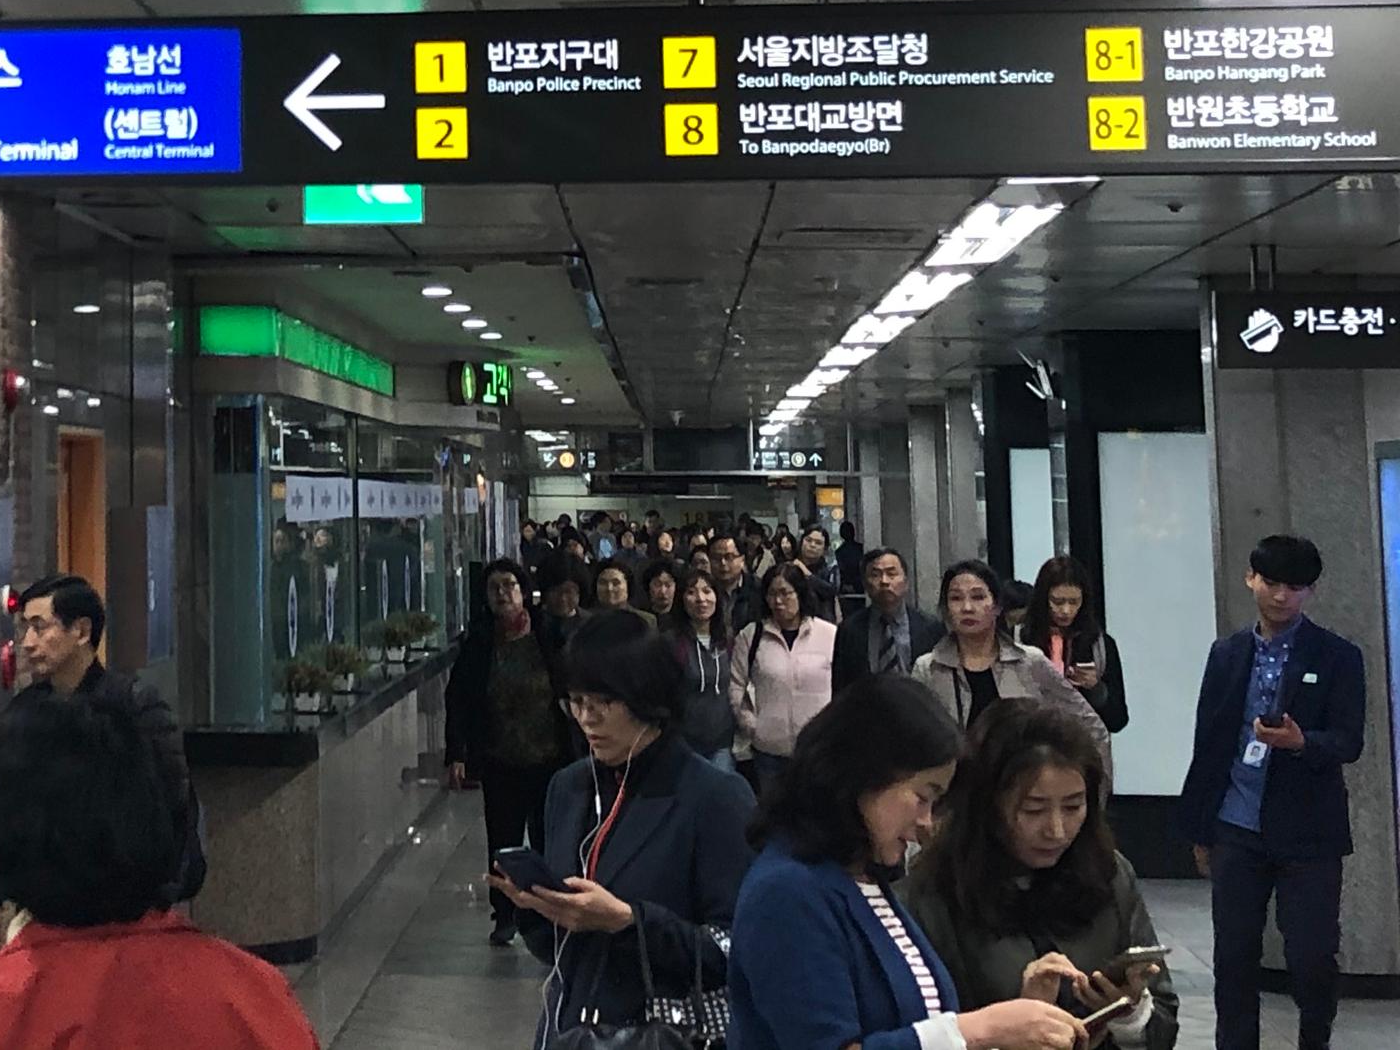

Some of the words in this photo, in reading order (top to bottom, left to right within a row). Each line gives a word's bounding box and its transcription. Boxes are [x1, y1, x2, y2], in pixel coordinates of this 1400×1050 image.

[487, 38, 618, 72] 반포지구대
[737, 33, 928, 67] 서울지방조달청
[1095, 40, 1136, 71] 8-1
[1163, 25, 1334, 60] 반포한강공원
[105, 43, 181, 76] 호남선
[433, 54, 444, 82] 1
[679, 49, 698, 78] 7
[1165, 66, 1215, 84] Banpo
[1217, 65, 1289, 83] Hangang
[1291, 63, 1327, 80] Park
[105, 80, 156, 95] Honam
[157, 80, 186, 95] Line
[487, 77, 534, 95] Banpo
[536, 76, 580, 93] Police
[582, 76, 642, 91] Precinct
[737, 73, 779, 89] Seoul
[782, 72, 847, 90] Regional
[850, 71, 897, 86] Public
[899, 70, 997, 86] Procurement
[999, 69, 1055, 85] Service
[104, 105, 198, 141] (센트럴)
[739, 99, 903, 134] 반포대교방면
[1095, 108, 1140, 140] 8-2
[1166, 94, 1339, 127] 반원초등학교
[434, 119, 454, 148] 2
[682, 115, 704, 146] 8
[1167, 133, 1231, 149] Banwon
[1233, 132, 1322, 150] Elementary
[1324, 130, 1377, 148] School
[104, 143, 154, 159] Central
[155, 142, 214, 159] Terminal
[740, 140, 760, 155] To
[762, 137, 890, 157] Banpodaegyo(Br)
